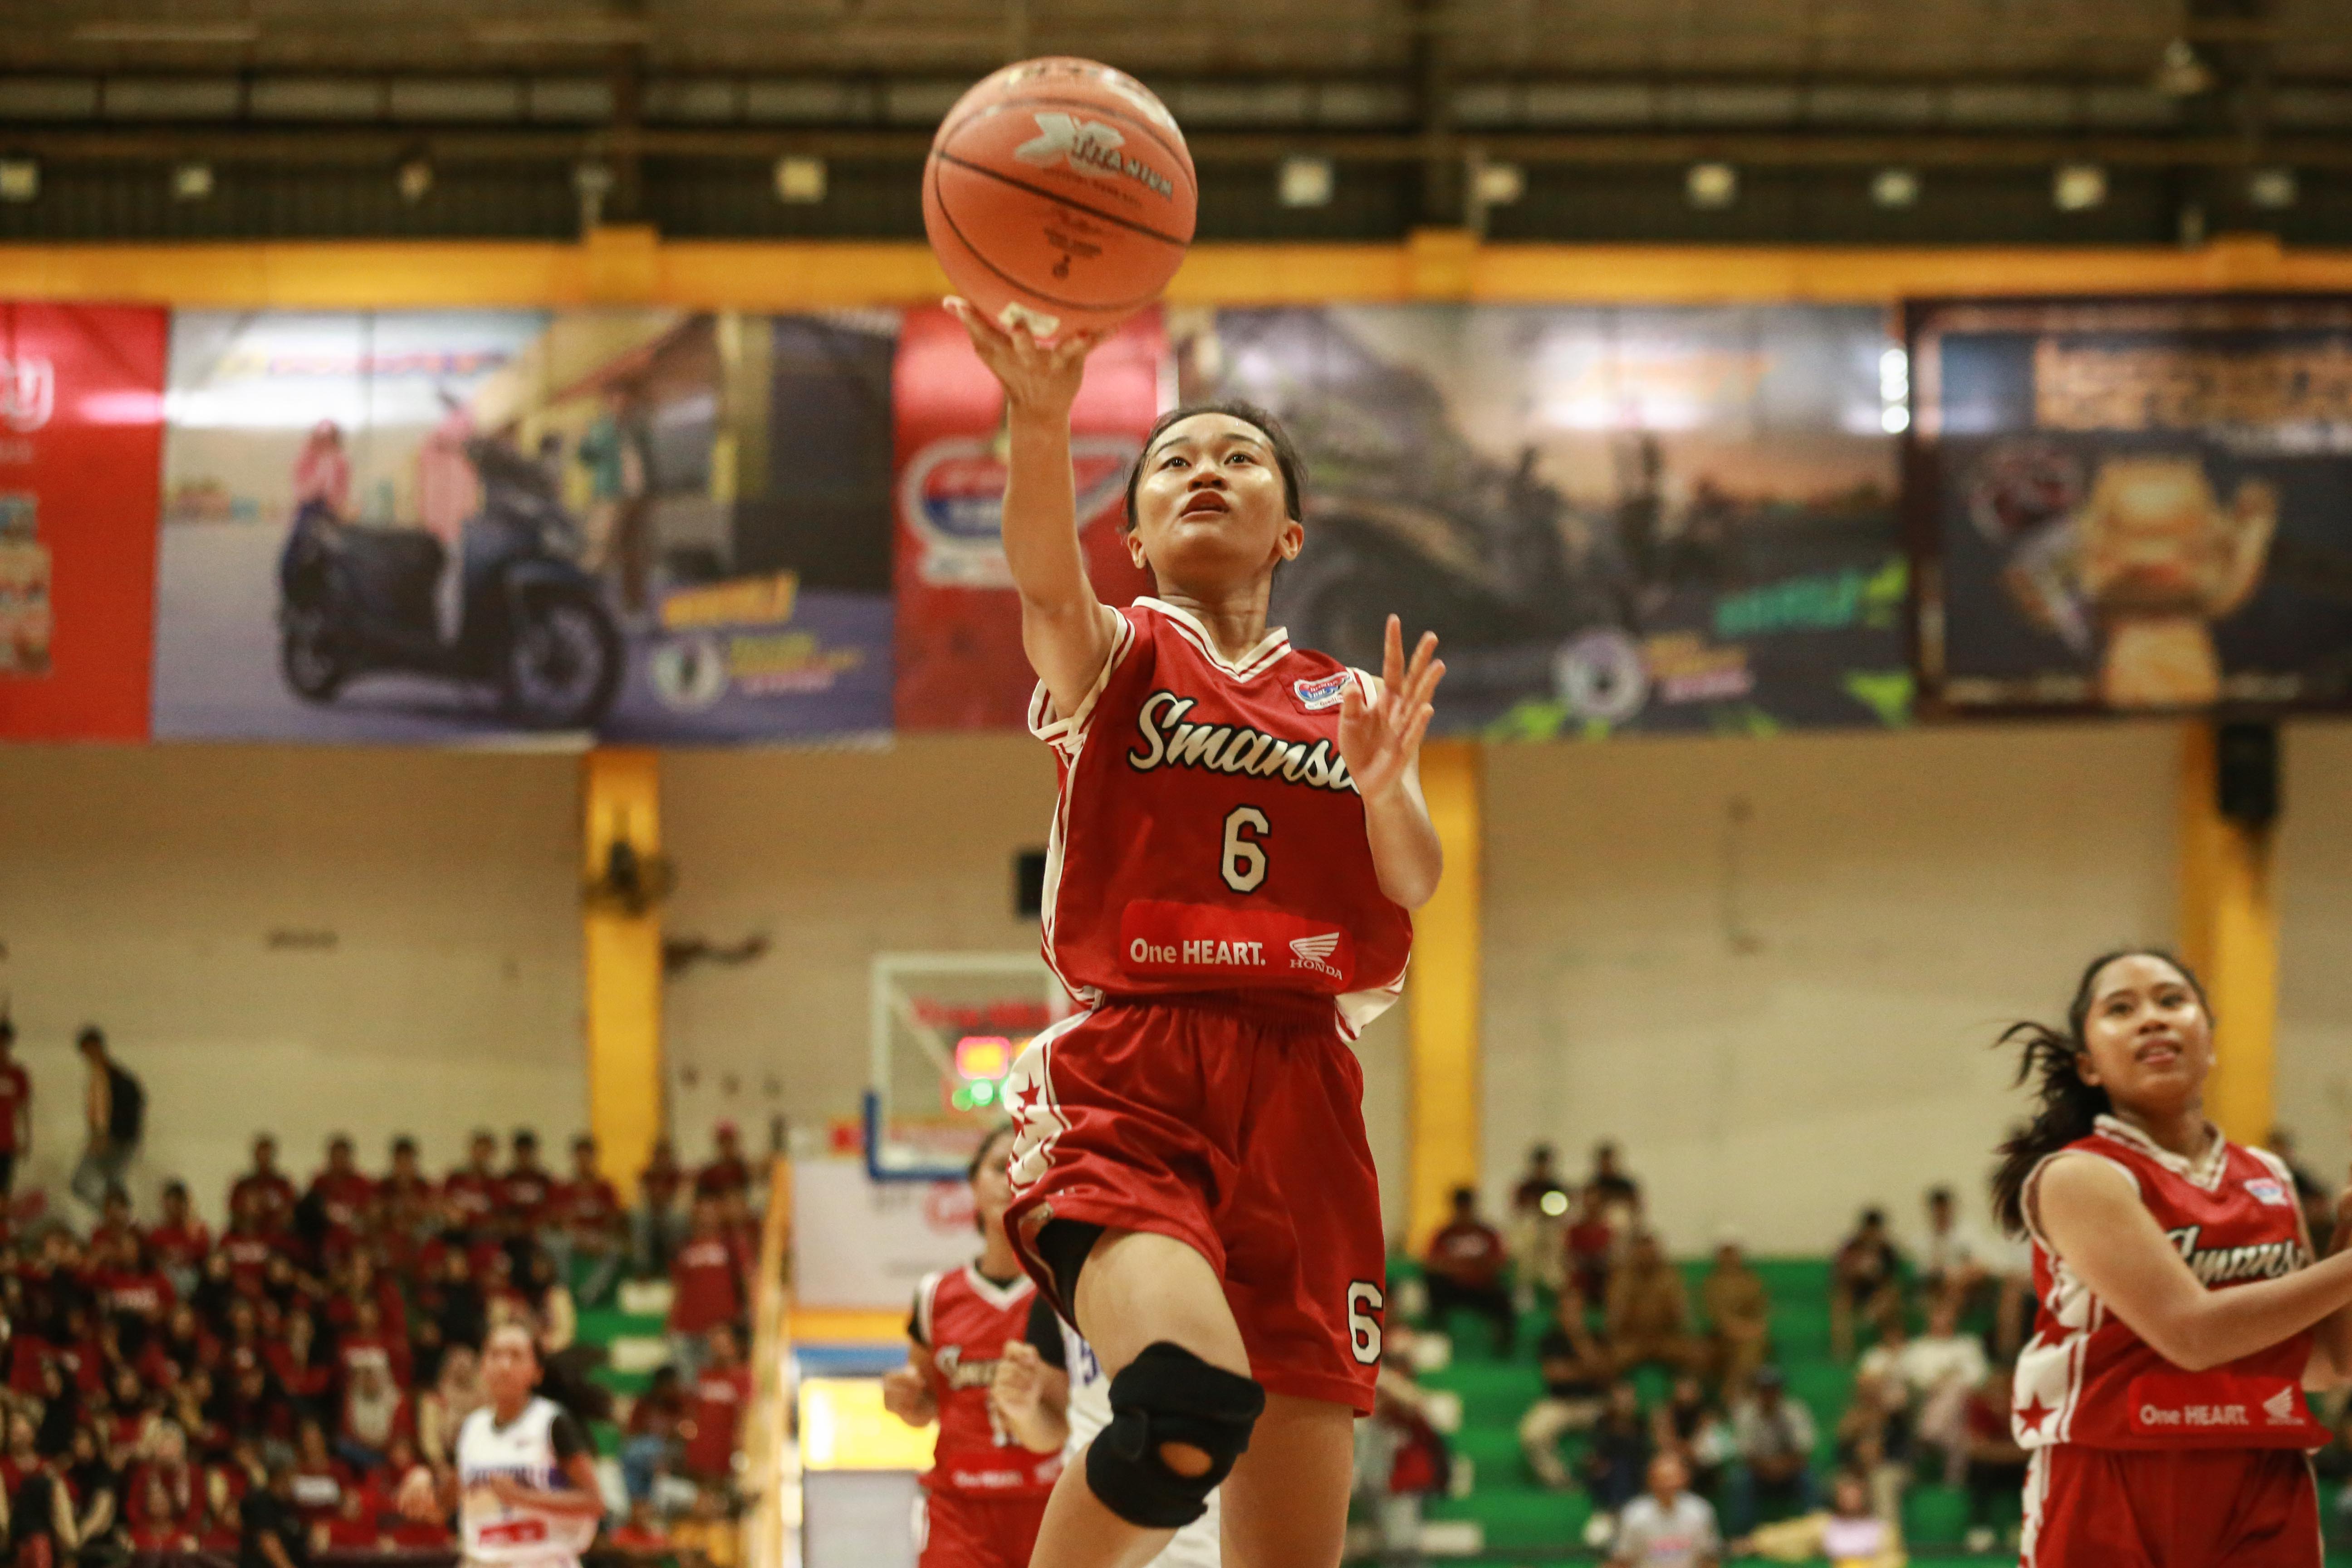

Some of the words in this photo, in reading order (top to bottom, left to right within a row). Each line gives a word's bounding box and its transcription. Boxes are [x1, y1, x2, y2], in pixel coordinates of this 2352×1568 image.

[1220, 804, 1272, 895] 6
[1130, 938, 1177, 963] One
[1183, 940, 1266, 965] HEART.
[1289, 959, 1343, 980] HONDA
[1347, 1279, 1383, 1365] 6
[2140, 1404, 2180, 1426] One
